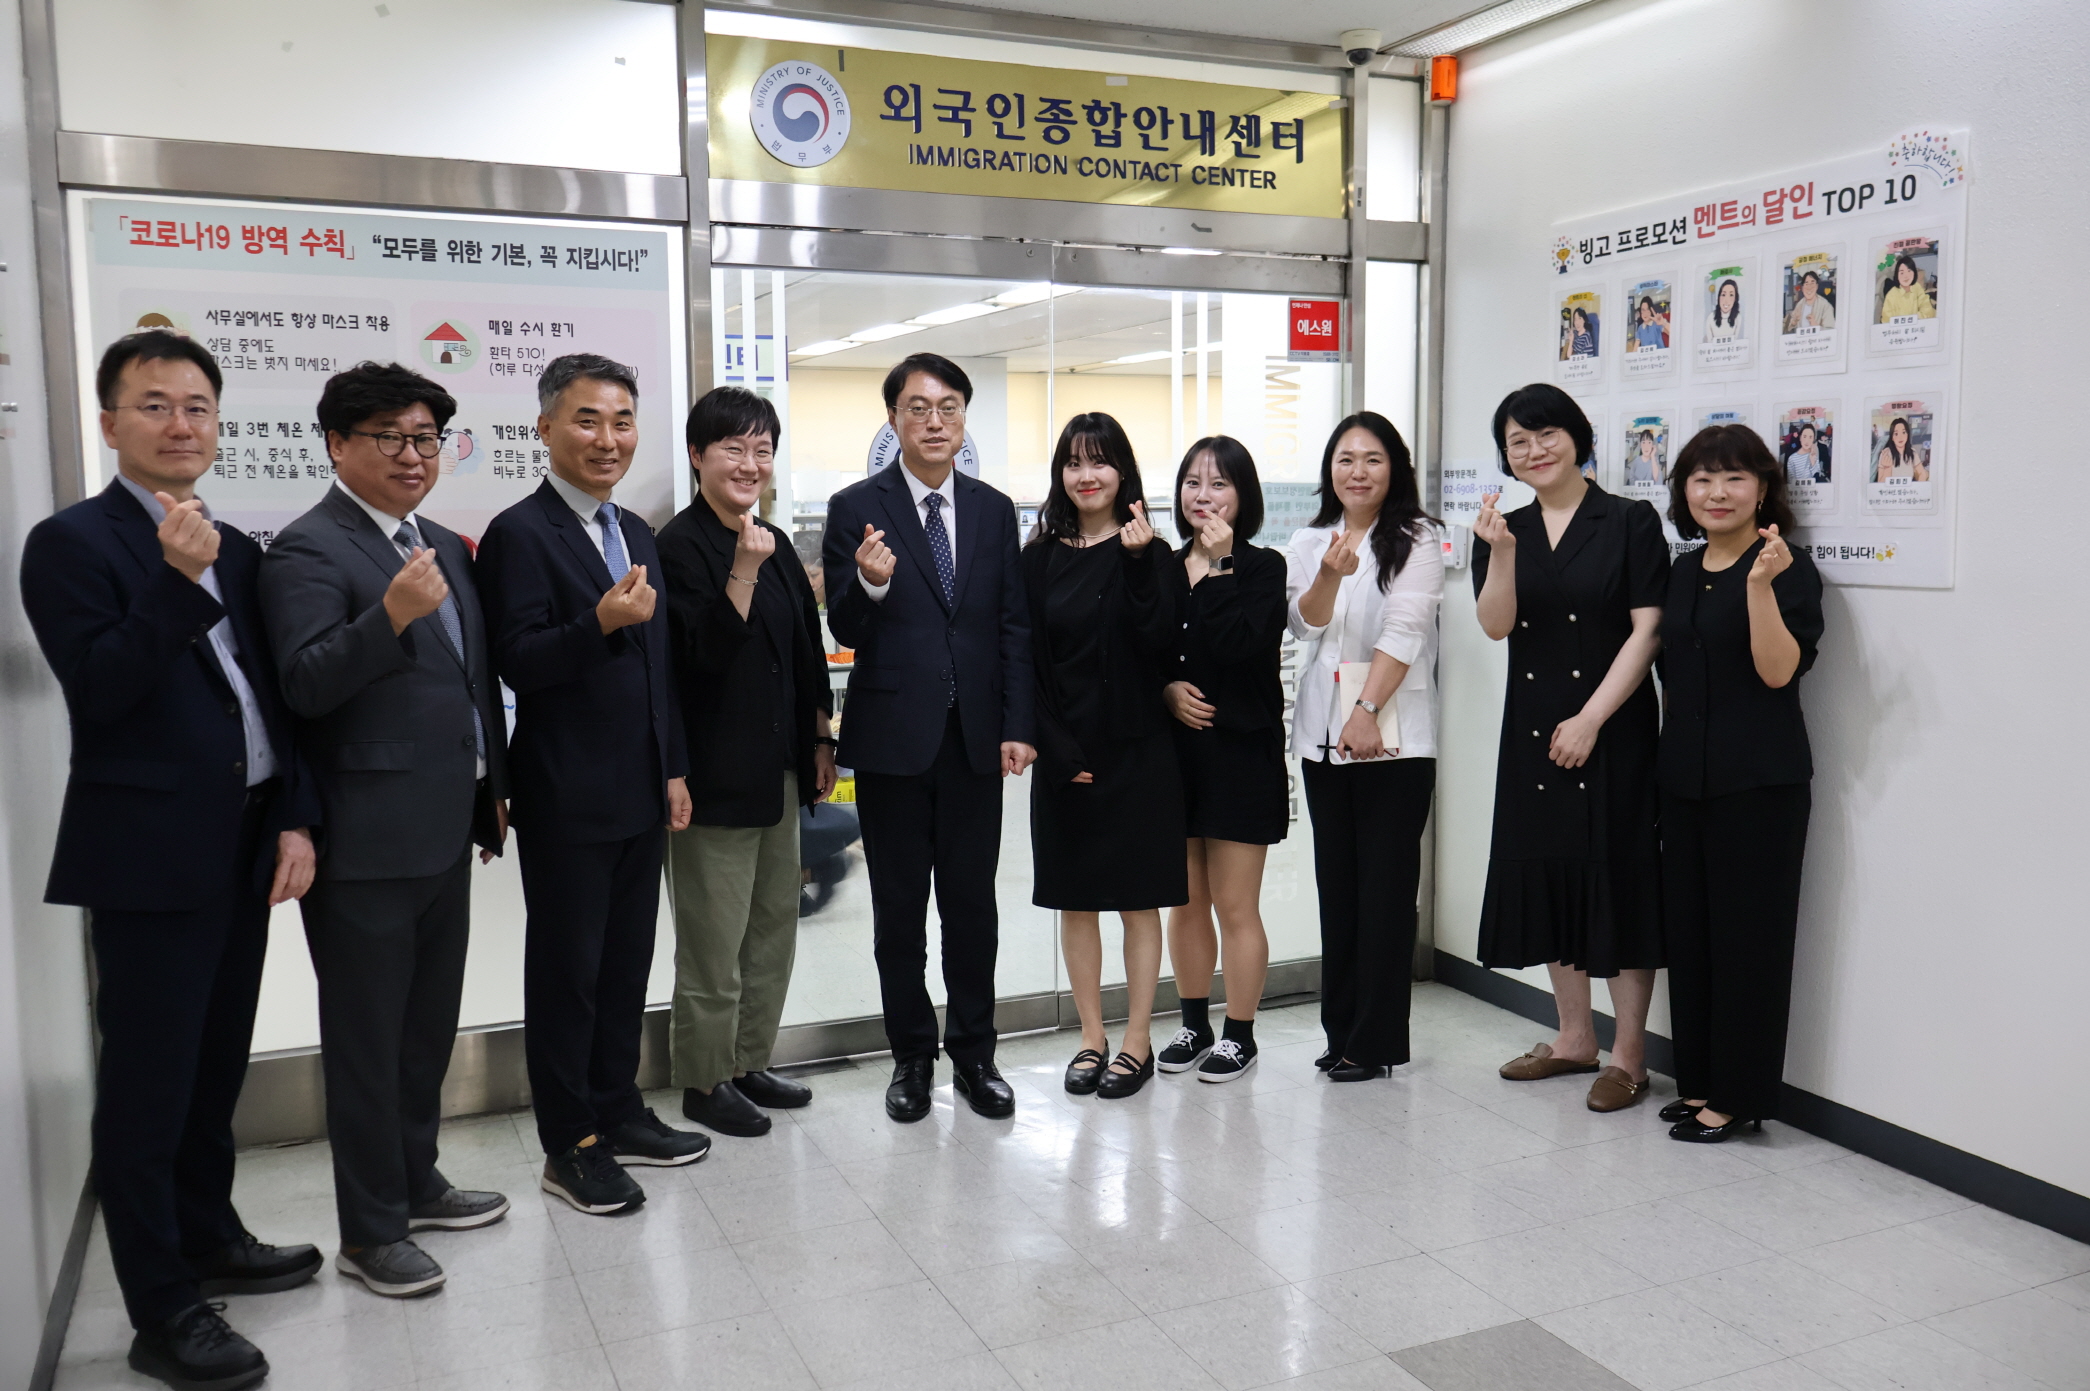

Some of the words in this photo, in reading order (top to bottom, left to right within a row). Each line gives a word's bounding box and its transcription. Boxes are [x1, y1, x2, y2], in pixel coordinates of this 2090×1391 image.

[756, 67, 789, 108] MINISTRY
[796, 66, 812, 76] OF
[816, 74, 845, 116] JUSTICE
[879, 83, 1305, 164] 외국인종합안내센터
[907, 143, 1068, 175] IMMIGRATION
[1077, 156, 1182, 184] CONTACT
[1190, 165, 1278, 190] CENTER
[1901, 142, 1956, 176] 축하합니다!
[1579, 236, 1612, 265] 빙고
[1615, 216, 1688, 254] 프로모션
[1693, 200, 1757, 239] 멘트의
[1762, 181, 1814, 226] 달인
[1821, 183, 1876, 216] TOP
[1884, 174, 1917, 205] 10
[241, 225, 288, 256] 방역
[299, 228, 355, 261] 수칙」
[372, 234, 438, 263] “모두를
[446, 239, 483, 265] 위한
[491, 243, 532, 269] 기본,
[540, 246, 558, 268] 꼭
[566, 247, 648, 273] 지킵시다!”
[206, 309, 284, 327] 사무실에서도
[291, 312, 316, 329] 항상
[322, 313, 360, 330] 마스크
[365, 315, 390, 332] 착용
[488, 320, 513, 336] 매일
[520, 322, 545, 337] 수시
[550, 322, 575, 338] 환기
[1297, 319, 1333, 337] 에스원
[206, 338, 232, 353] 상담
[238, 338, 275, 353] 중에도
[489, 346, 512, 360] 환타
[264, 356, 289, 372] 벗지
[295, 357, 338, 373] 마세요!
[489, 362, 517, 377] (하루
[246, 422, 269, 438] 3번
[276, 422, 303, 438] 체온
[310, 422, 324, 439] 체
[244, 447, 260, 462] 시,
[268, 447, 292, 462] 중식
[298, 448, 314, 462] 후,
[493, 449, 526, 464] 흐르는
[213, 464, 238, 479] 퇴근
[244, 464, 257, 479] 전
[263, 464, 299, 479] 체온을
[493, 465, 526, 479] 비누로
[1443, 469, 1478, 479] 외부방문객은
[1443, 501, 1456, 511] 연락
[1816, 546, 1836, 559] 힘이
[1839, 547, 1875, 560] 됩니다!
